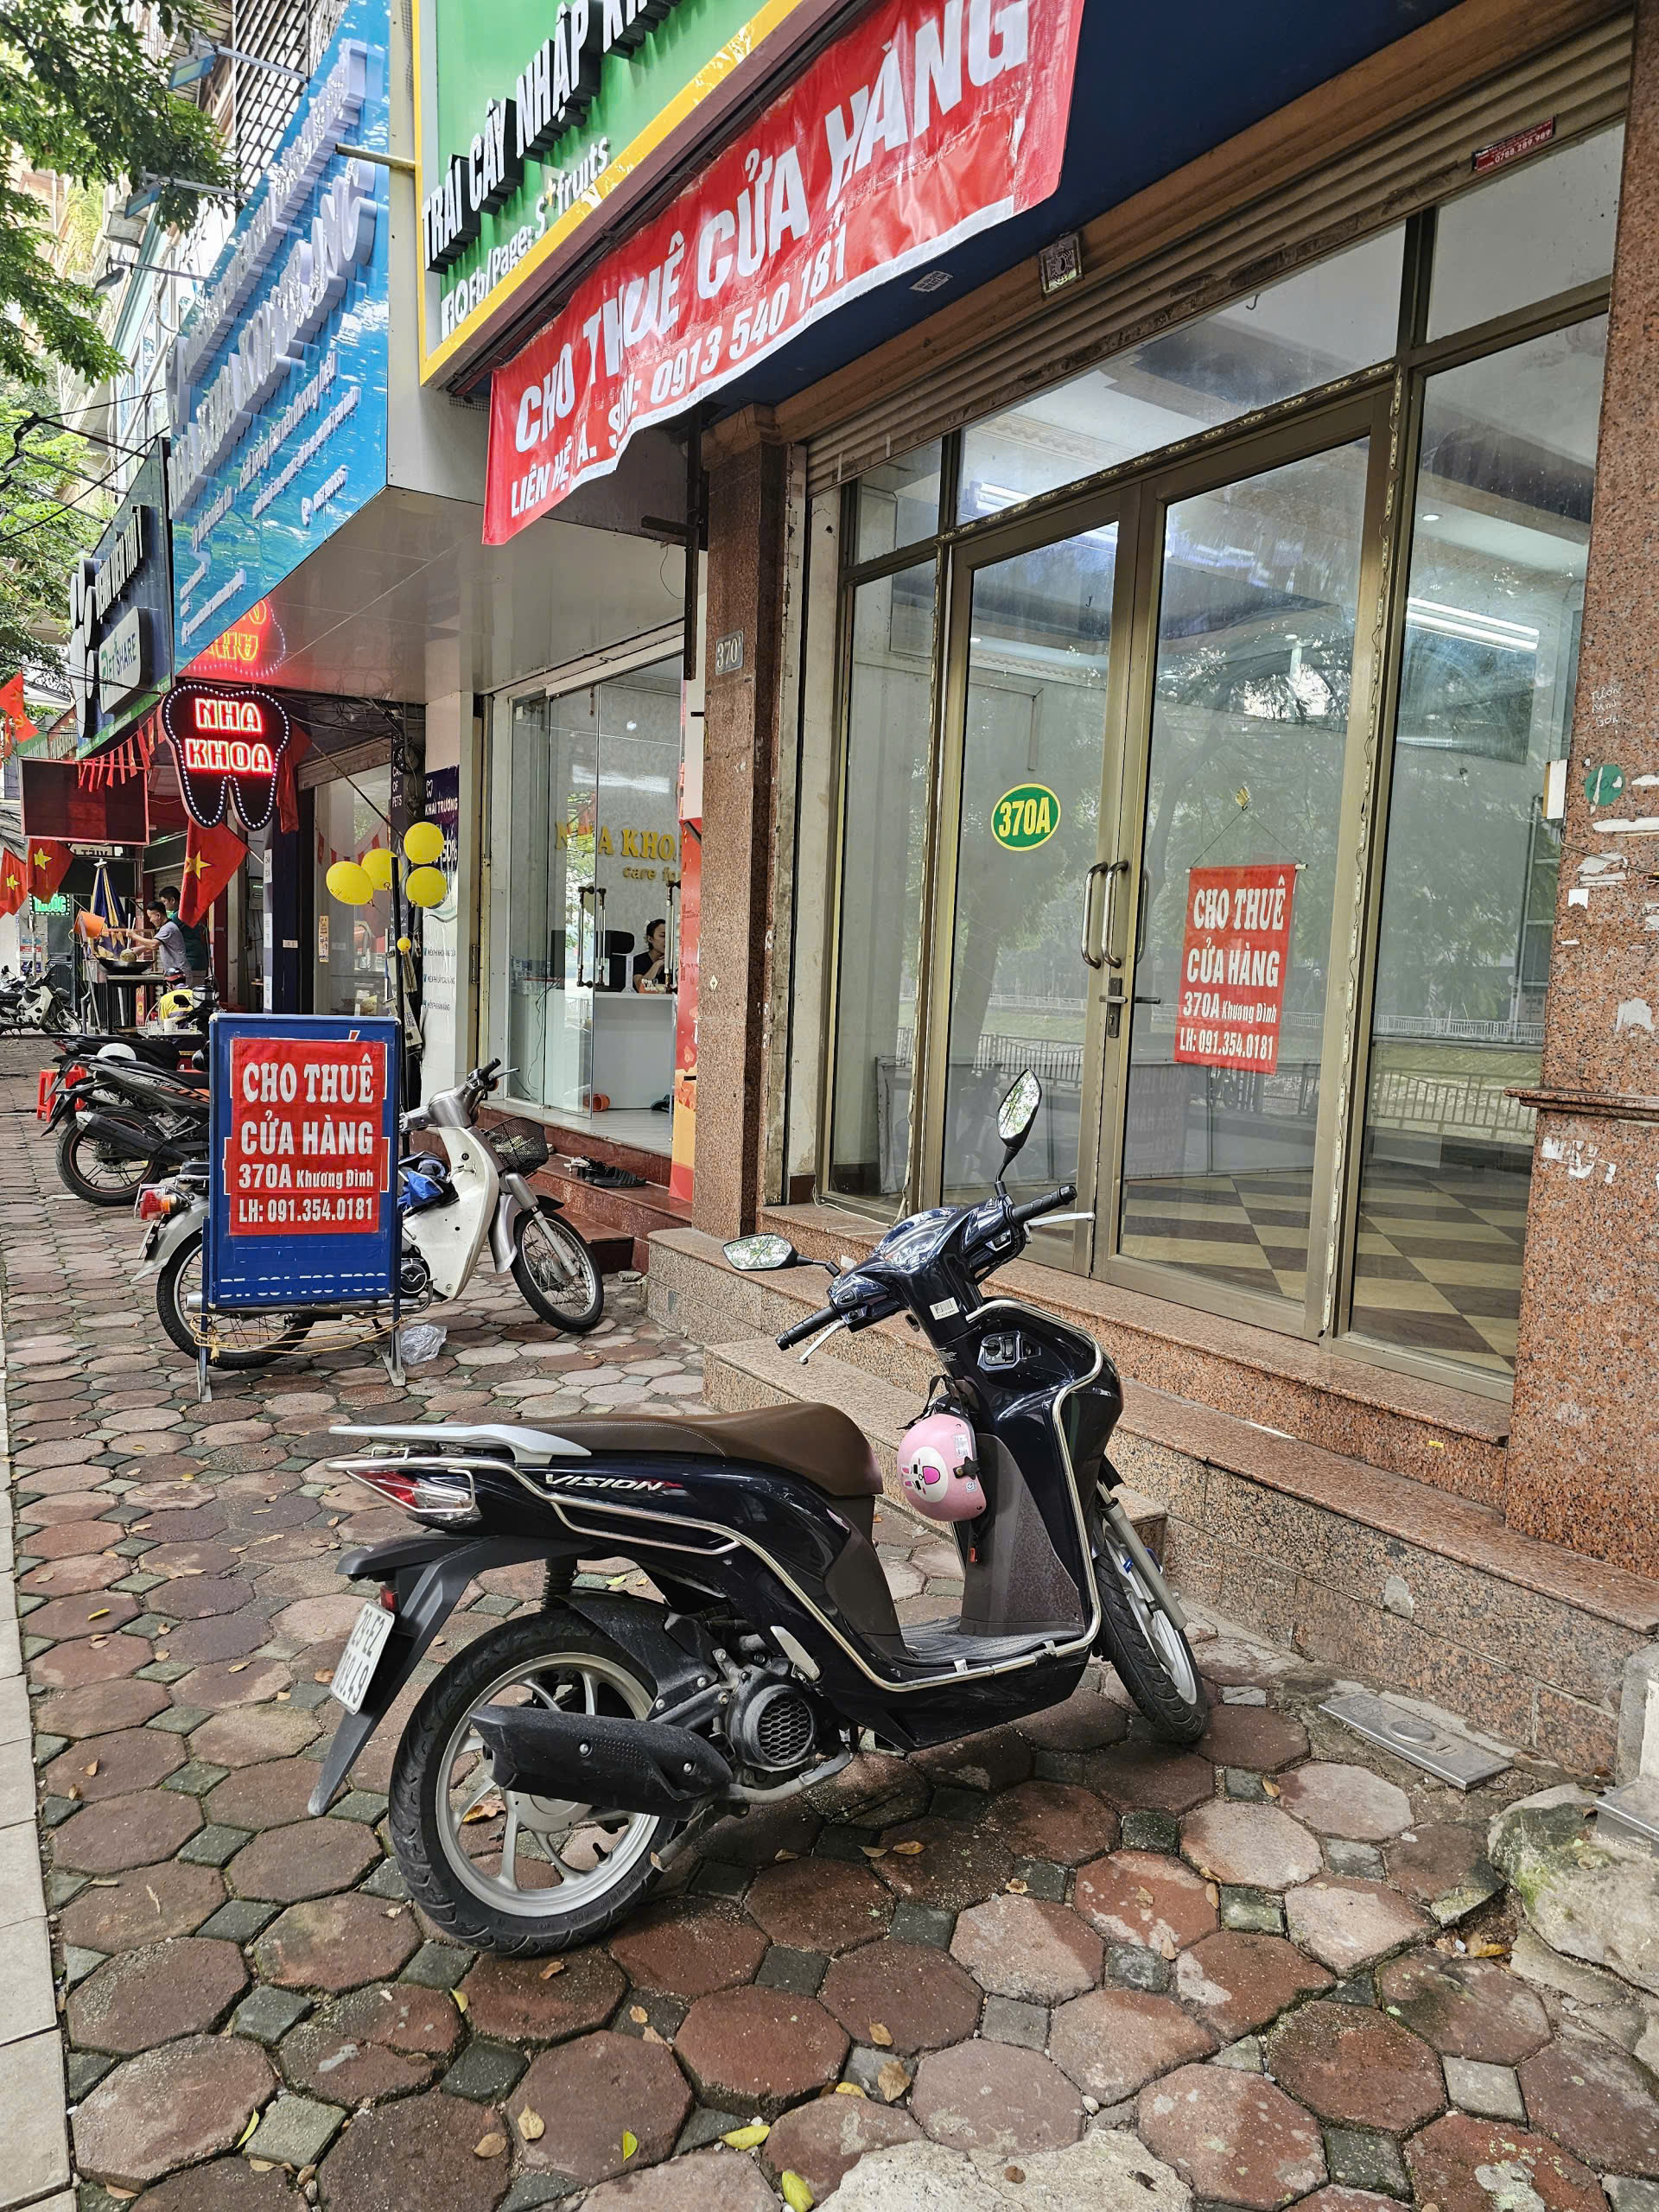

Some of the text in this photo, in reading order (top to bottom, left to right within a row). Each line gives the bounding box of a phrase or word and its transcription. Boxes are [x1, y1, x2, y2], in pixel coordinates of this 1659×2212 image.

[423, 0, 589, 271] TRÁI CÂY NHẬP
[515, 343, 575, 452] CHO
[582, 230, 685, 387] THUÊ
[696, 148, 810, 299] CỬA
[825, 0, 1028, 212] HÀNG
[511, 463, 551, 518] LIÊN
[551, 435, 573, 491] HỆ
[576, 421, 597, 468] A.
[650, 325, 723, 404] 0913
[729, 282, 791, 360] 540
[798, 222, 847, 313] 181
[195, 697, 263, 732] NHA
[185, 738, 273, 773] KHOA
[391, 795, 403, 808] PETS
[424, 801, 437, 816] KHAI
[998, 797, 1051, 837] 370A
[623, 865, 657, 880] care
[1193, 874, 1286, 931] CHO THUÊ
[1186, 937, 1280, 987] CỬA HÀNG
[1182, 992, 1277, 1024] 370A Khương Đình
[1179, 1029, 1274, 1060] LH: 091.354.0181
[243, 1052, 374, 1104] CHO THUÊ
[241, 1109, 373, 1156] CỬA HÀNG
[238, 1163, 374, 1189] 370A Khương Đình
[238, 1198, 372, 1224] LH: 091.354.0181
[545, 1473, 664, 1491] VISION
